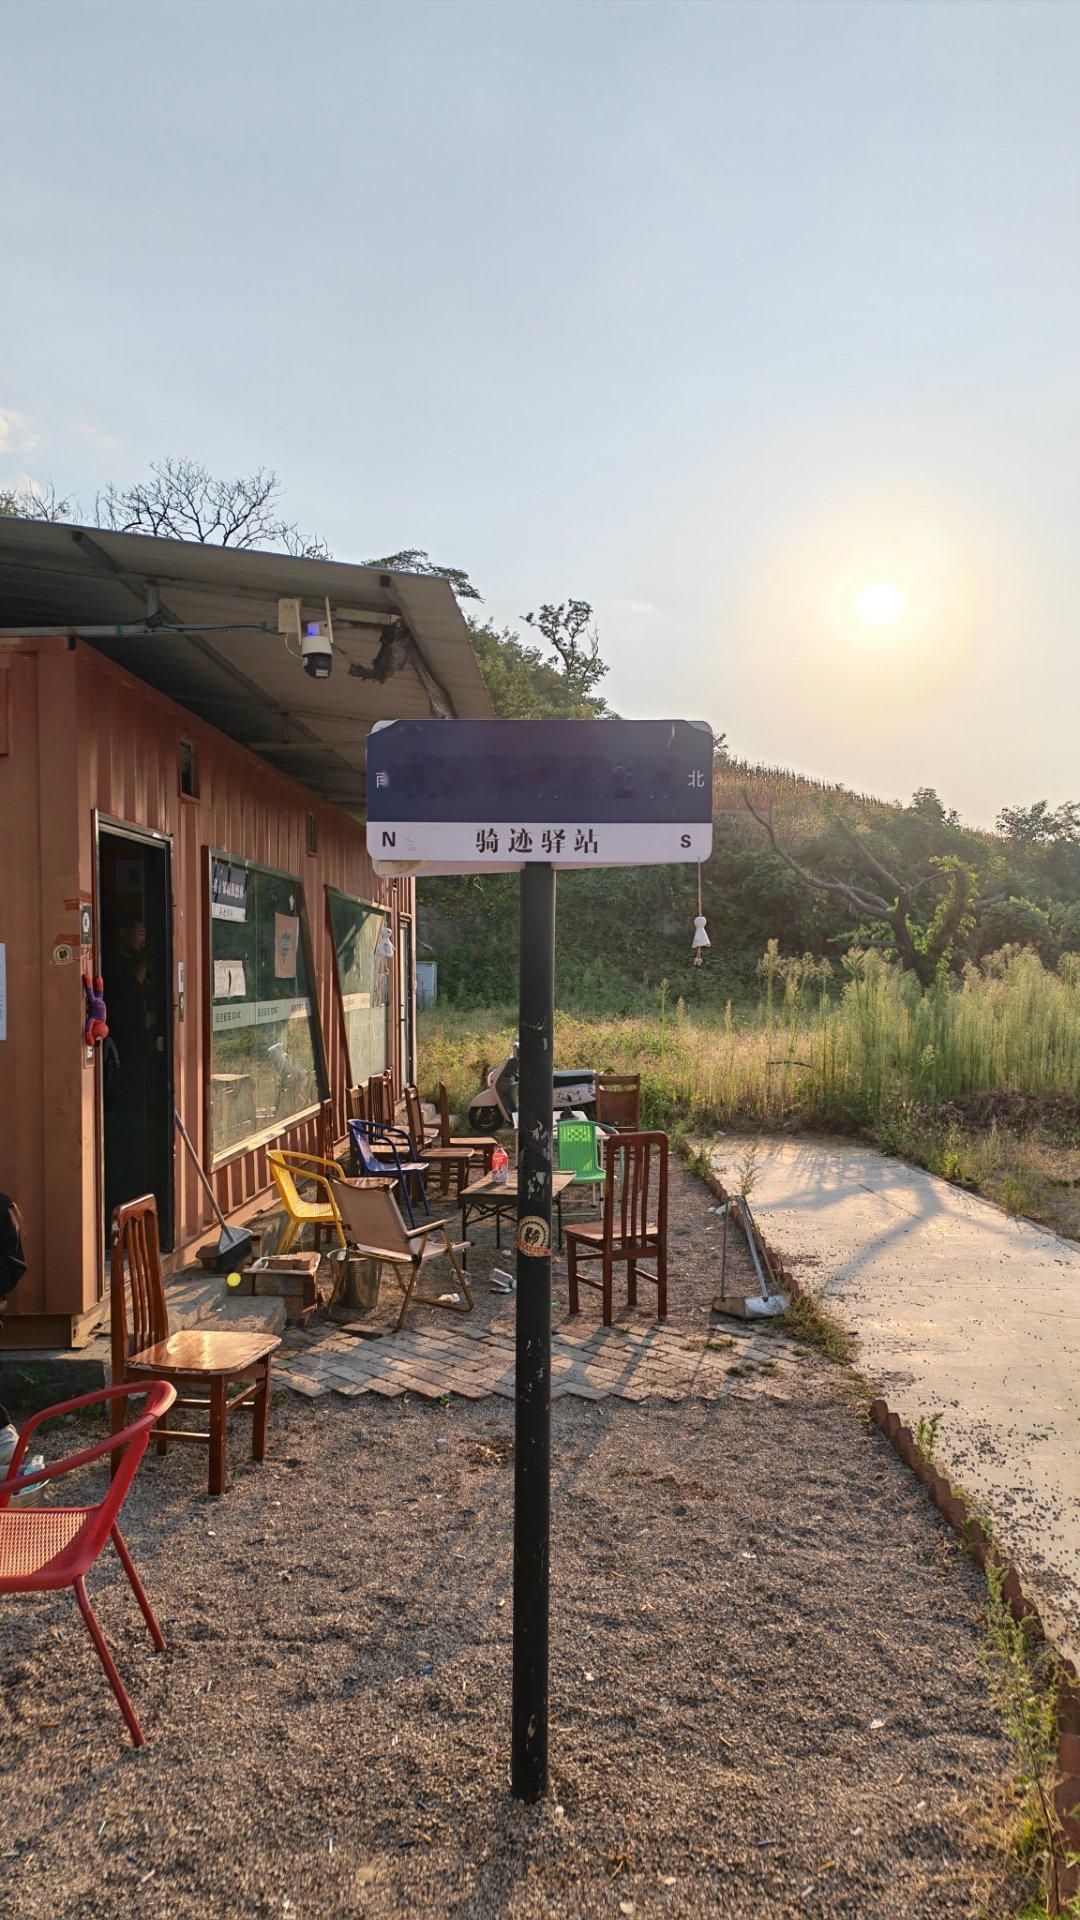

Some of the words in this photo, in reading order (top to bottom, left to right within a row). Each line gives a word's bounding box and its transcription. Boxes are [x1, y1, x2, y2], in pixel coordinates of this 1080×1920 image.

[687, 770, 705, 788] 北
[382, 831, 396, 848] N
[475, 827, 598, 854] 骑迹驿站
[680, 834, 692, 849] S
